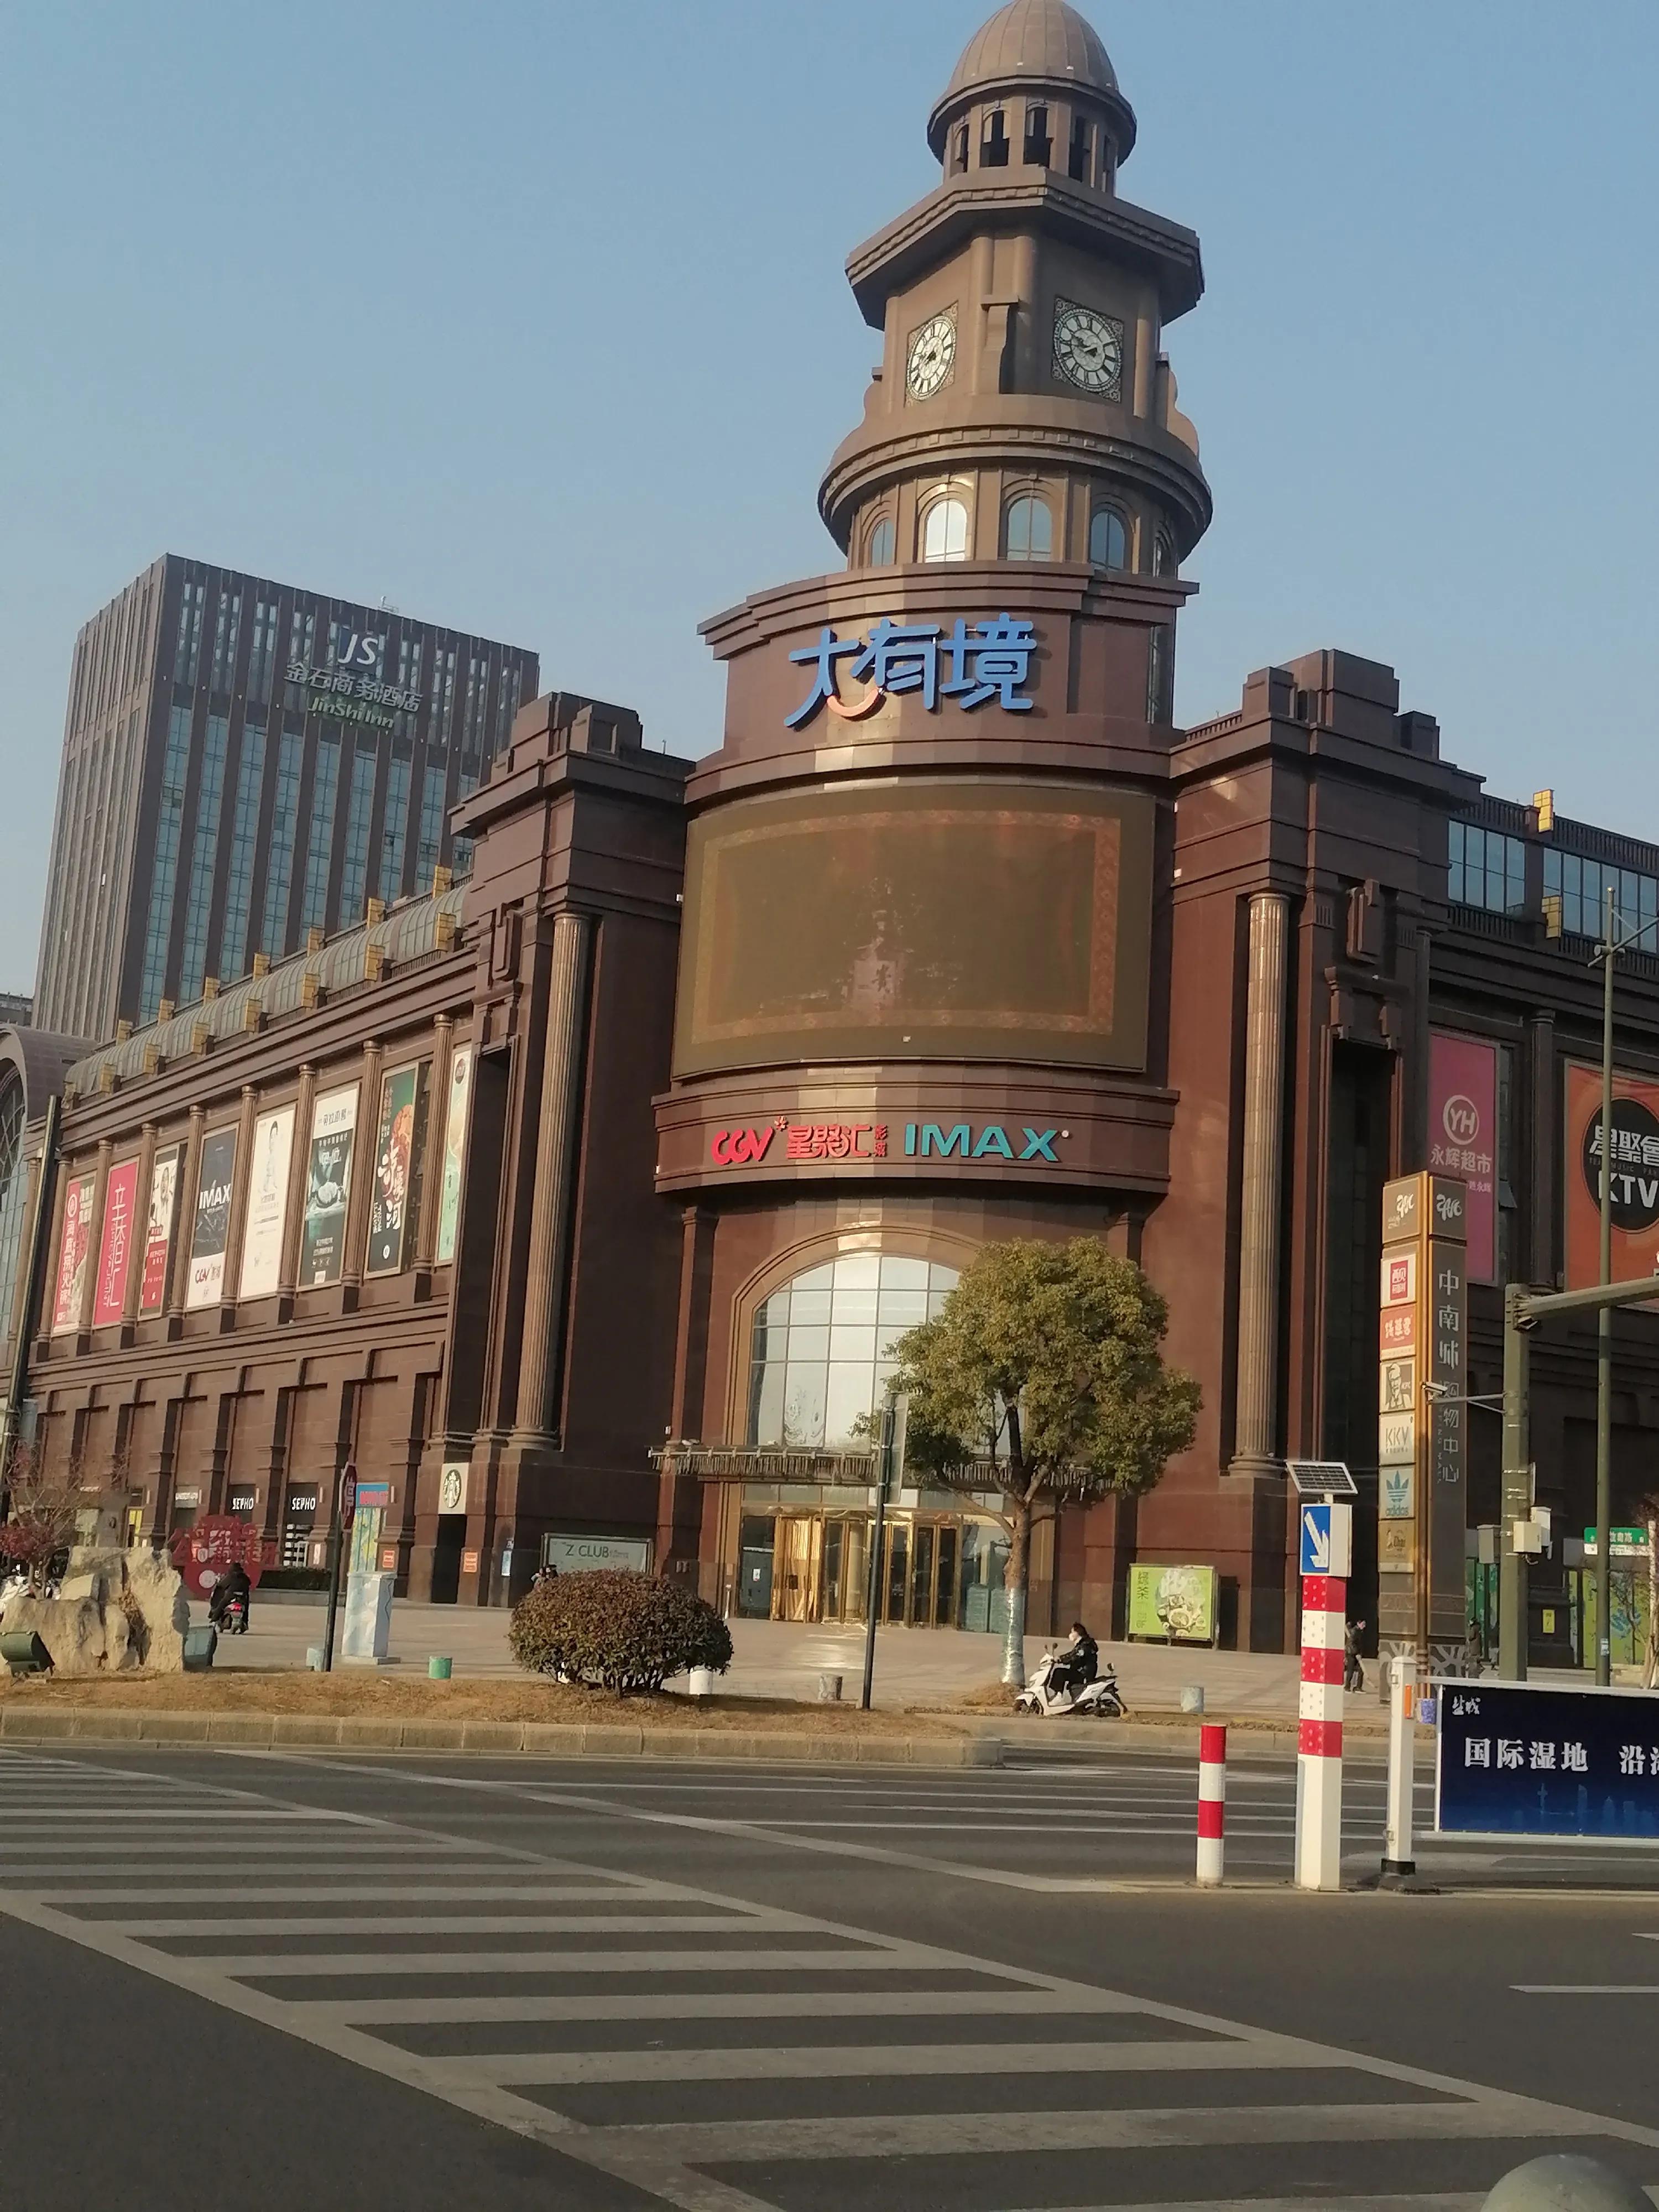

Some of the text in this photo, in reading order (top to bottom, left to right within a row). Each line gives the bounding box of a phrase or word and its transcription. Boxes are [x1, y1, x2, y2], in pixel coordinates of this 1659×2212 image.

[338, 634, 378, 665] JS
[284, 661, 423, 712] 金石商务酒店
[365, 710, 394, 728] Inn
[1450, 1108, 1475, 1135] YH
[711, 1126, 774, 1165] CGV
[905, 1123, 1060, 1161] IMAX
[1430, 1144, 1493, 1173] 永辉超市
[198, 1183, 231, 1209] IMAX
[1599, 1170, 1658, 1208] KTV
[1385, 1505, 1409, 1516] adidas
[565, 1545, 575, 1556] Z
[578, 1545, 609, 1557] CLUB
[1464, 1737, 1588, 1772] 国际湿地
